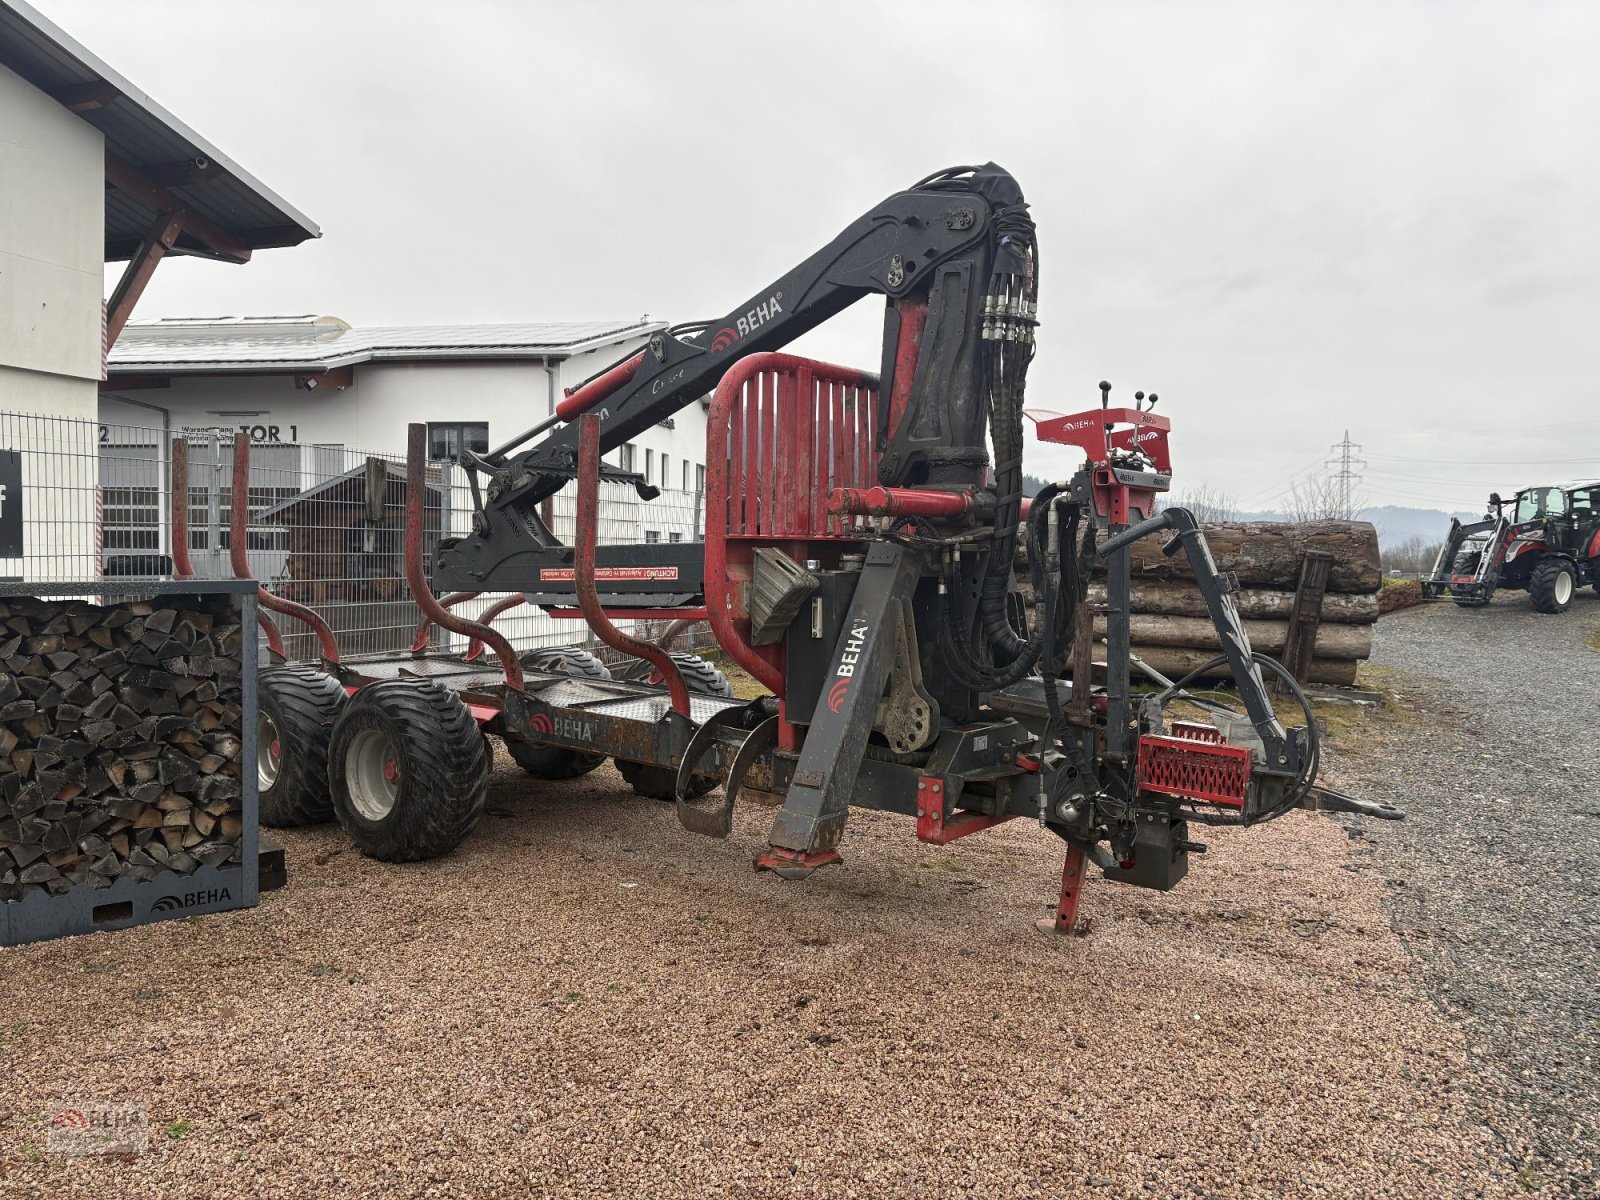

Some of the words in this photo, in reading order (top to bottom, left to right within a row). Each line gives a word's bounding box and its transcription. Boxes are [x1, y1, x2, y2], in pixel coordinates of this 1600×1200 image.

[239, 424, 281, 442] TOR
[290, 425, 297, 442] 1
[1074, 419, 1095, 430] BEHA
[99, 425, 109, 442] 2
[184, 887, 232, 908] BEHA
